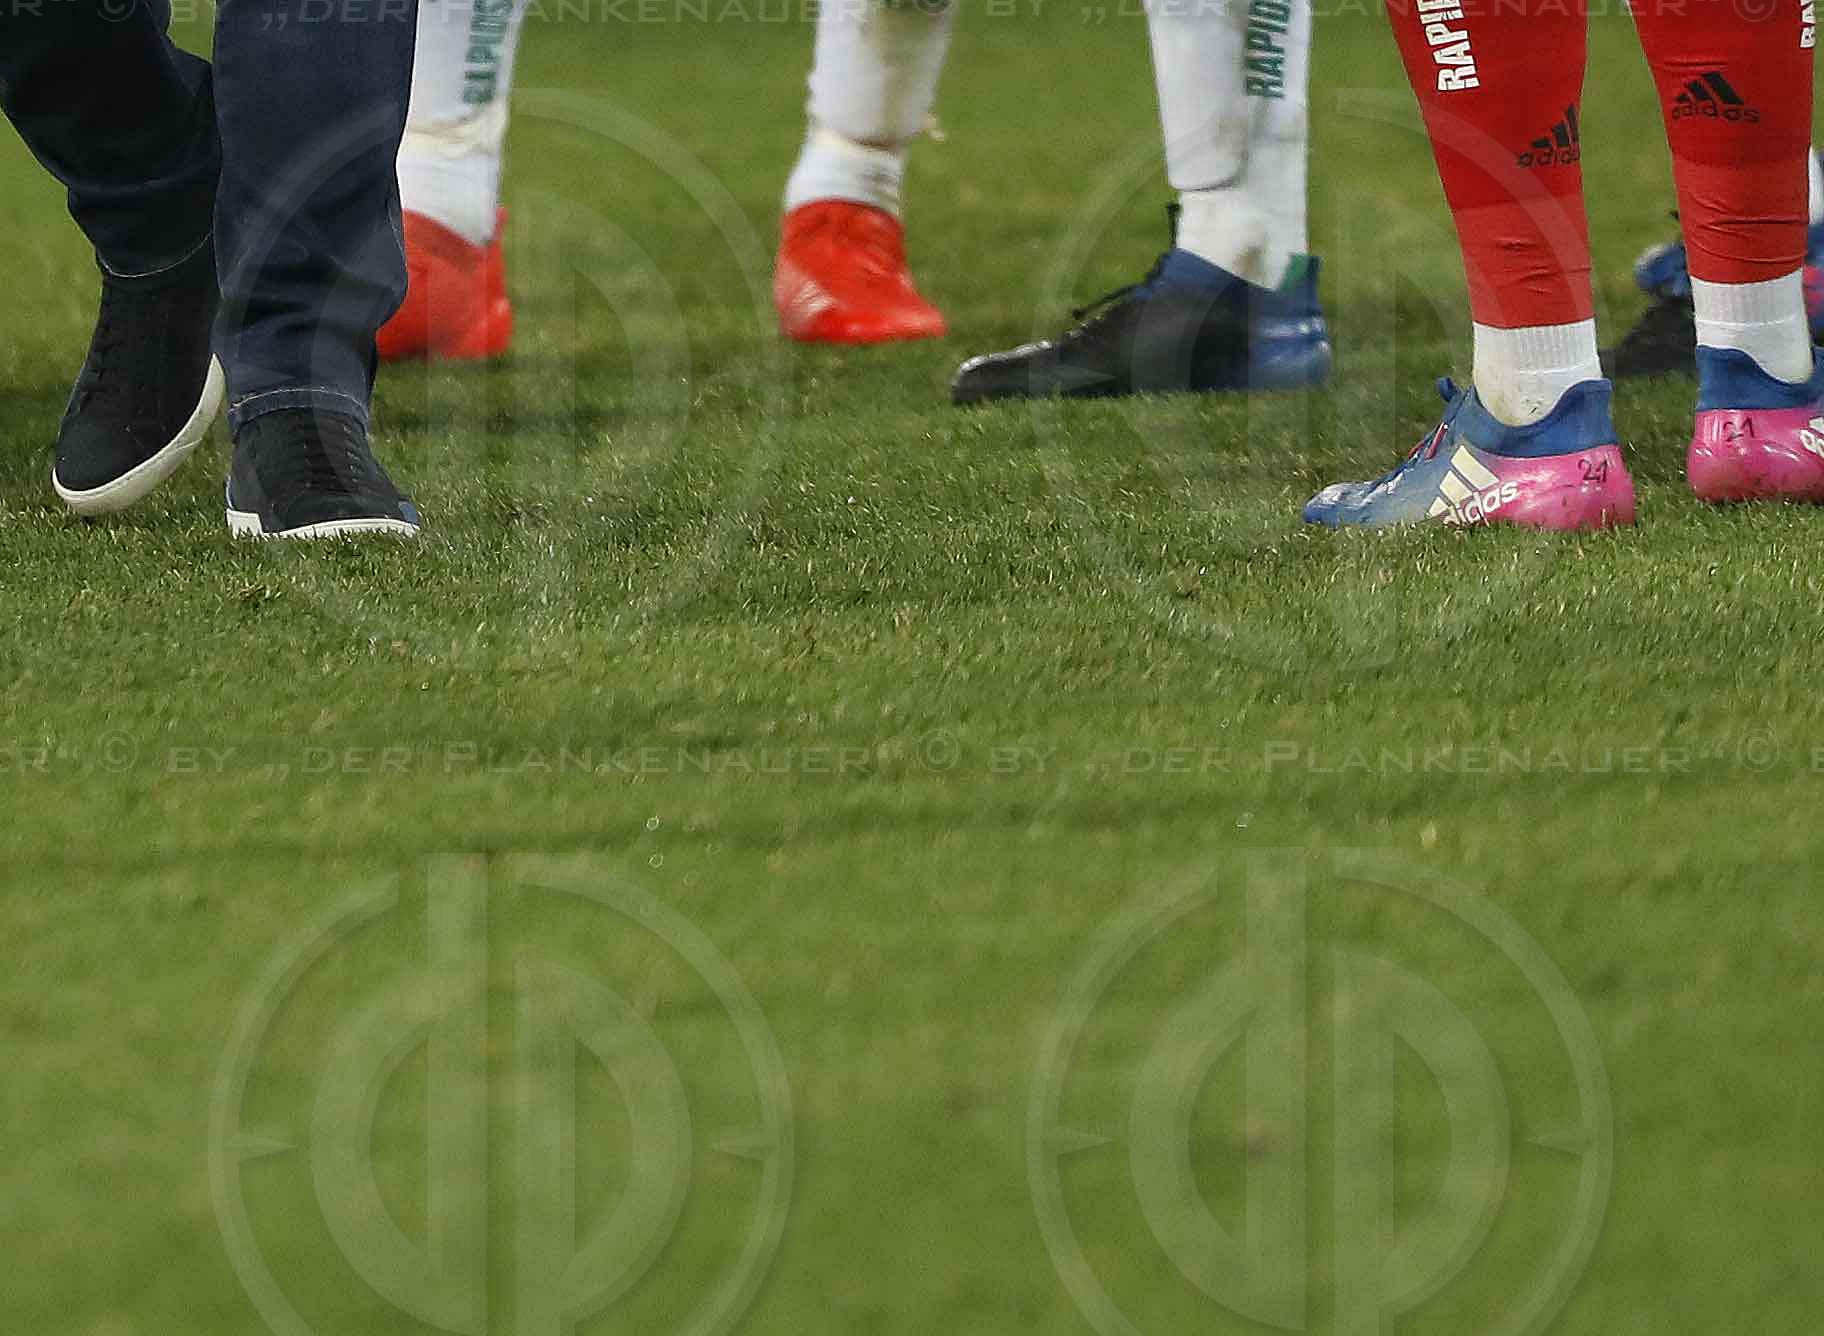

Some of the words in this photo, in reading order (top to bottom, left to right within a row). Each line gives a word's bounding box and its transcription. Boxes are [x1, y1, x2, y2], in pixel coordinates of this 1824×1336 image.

[1670, 102, 1761, 125] adidas
[1578, 459, 1608, 483] 21
[1442, 481, 1520, 528] didas
